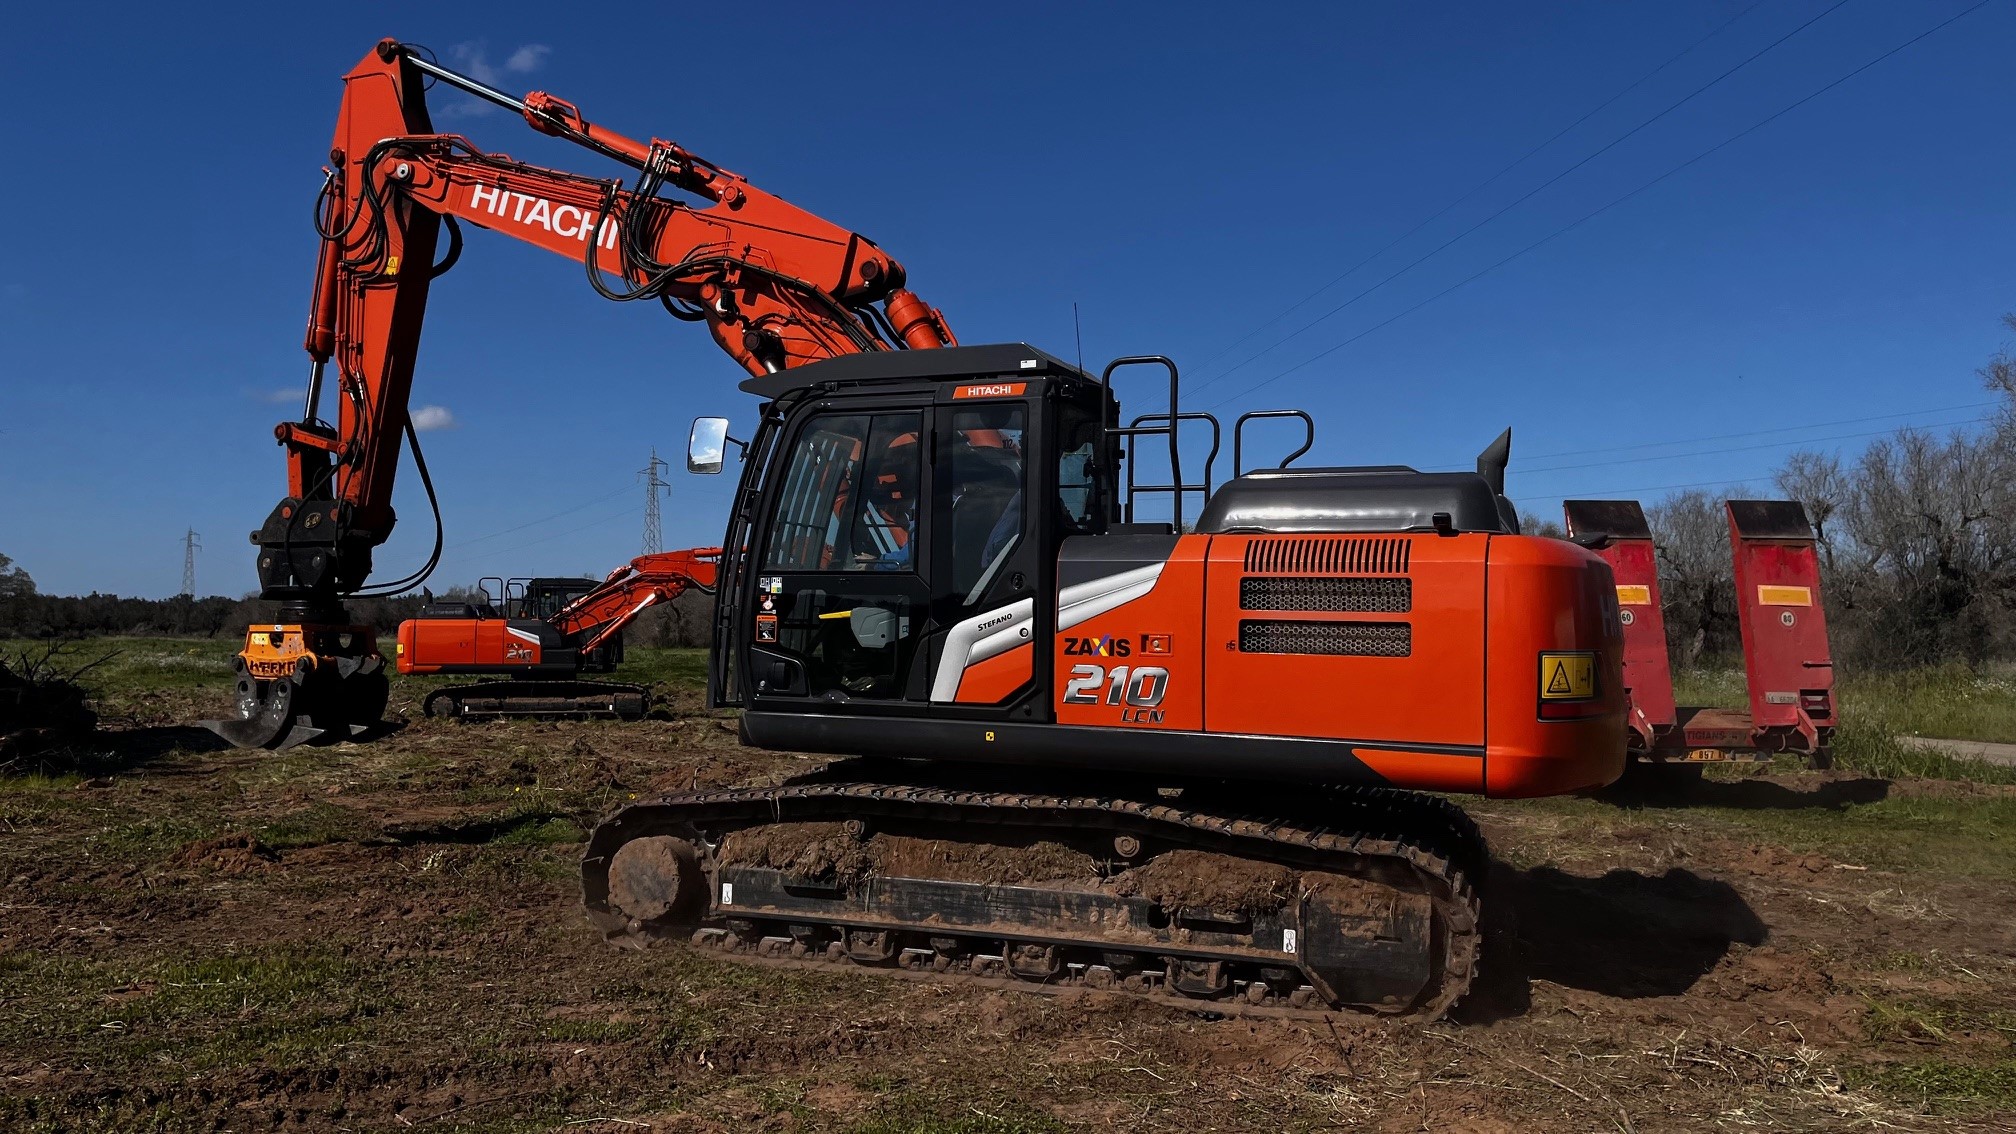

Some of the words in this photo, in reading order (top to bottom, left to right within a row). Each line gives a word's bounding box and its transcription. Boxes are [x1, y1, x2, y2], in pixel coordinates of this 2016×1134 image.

[470, 183, 619, 250] HITACHI
[967, 385, 1011, 396] HITACHI
[977, 613, 1013, 631] STEFANO
[1621, 613, 1631, 622] 60
[1064, 633, 1131, 657] ZAXIS
[1063, 664, 1170, 707] 210
[1120, 707, 1165, 724] LCN
